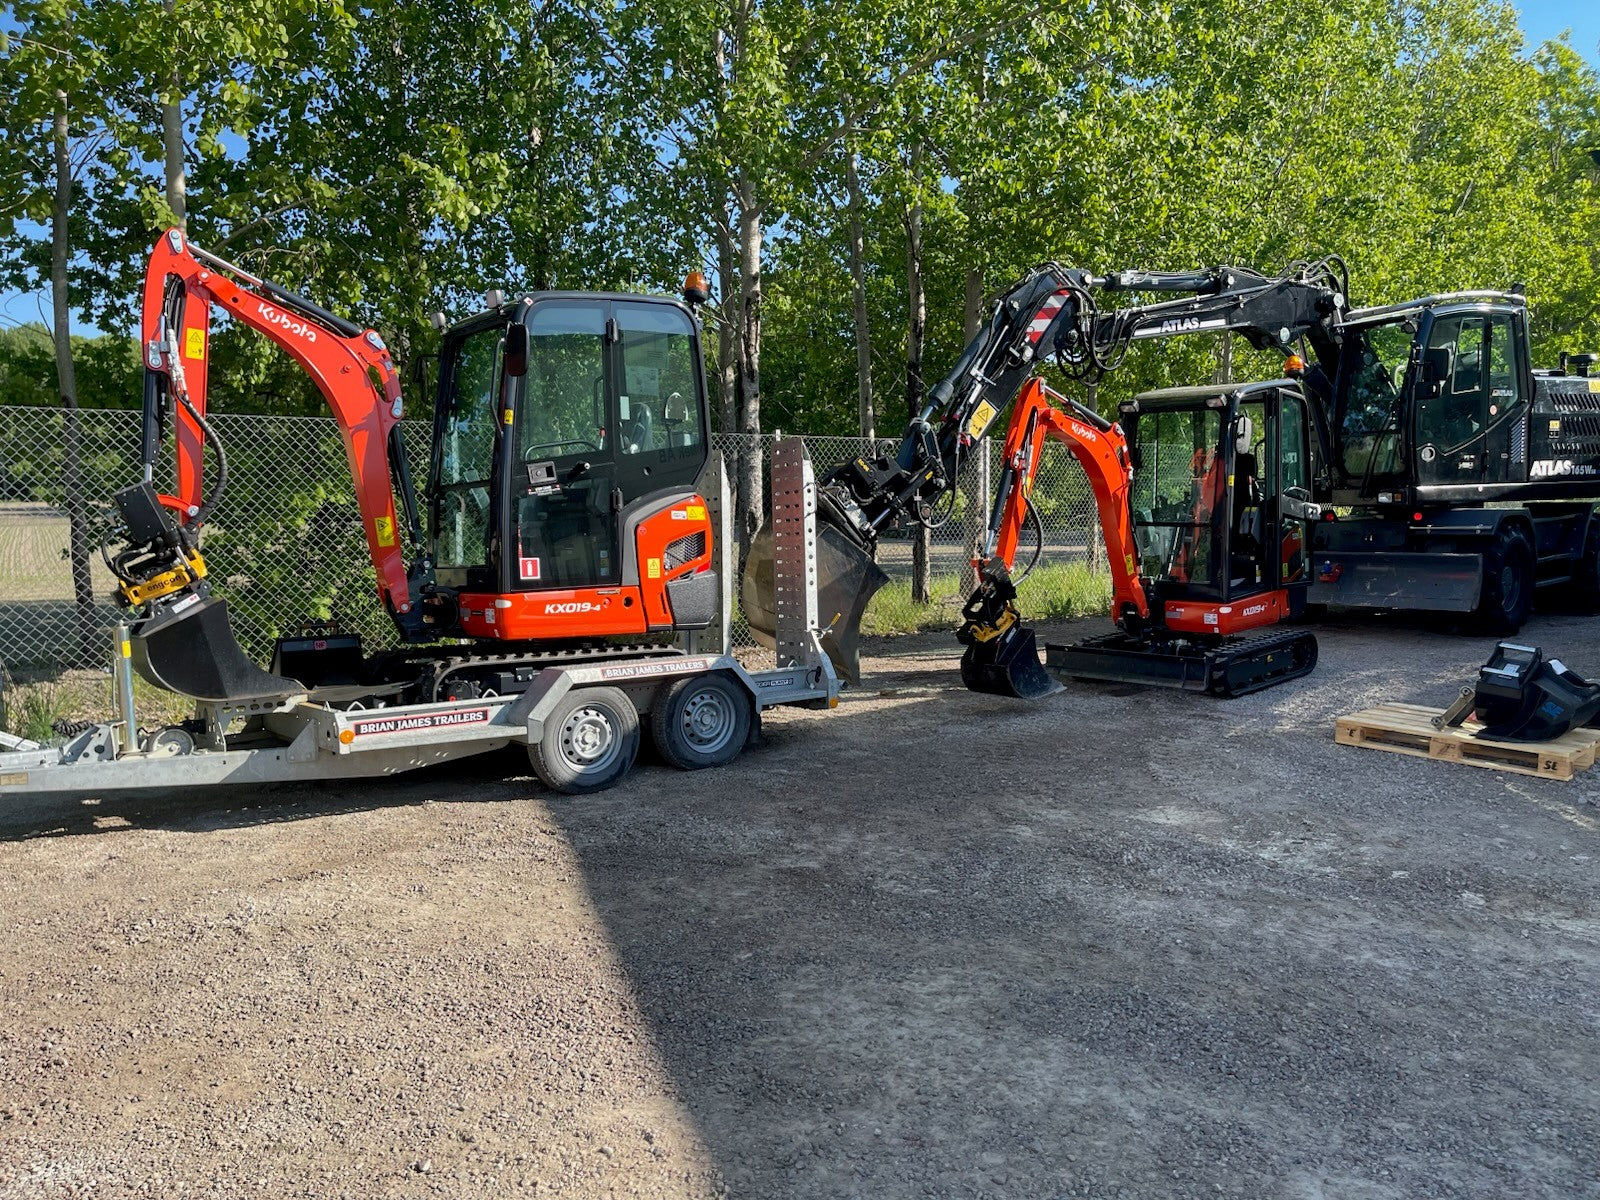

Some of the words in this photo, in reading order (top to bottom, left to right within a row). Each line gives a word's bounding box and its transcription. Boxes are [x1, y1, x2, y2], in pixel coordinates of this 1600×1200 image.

[258, 302, 317, 343] Kubota
[1161, 317, 1200, 333] ATLAS
[1071, 421, 1097, 442] Kubota
[1530, 460, 1571, 477] ATLAS
[147, 575, 182, 592] engcon
[544, 602, 601, 614] KX019-4
[605, 668, 636, 678] BRIAN
[636, 665, 664, 676] JAMES
[663, 661, 704, 673] TRAILERS
[360, 722, 395, 734] BRIAN
[395, 717, 432, 731] JAMES
[433, 711, 484, 726] TRAILERS
[1543, 760, 1559, 771] SE
